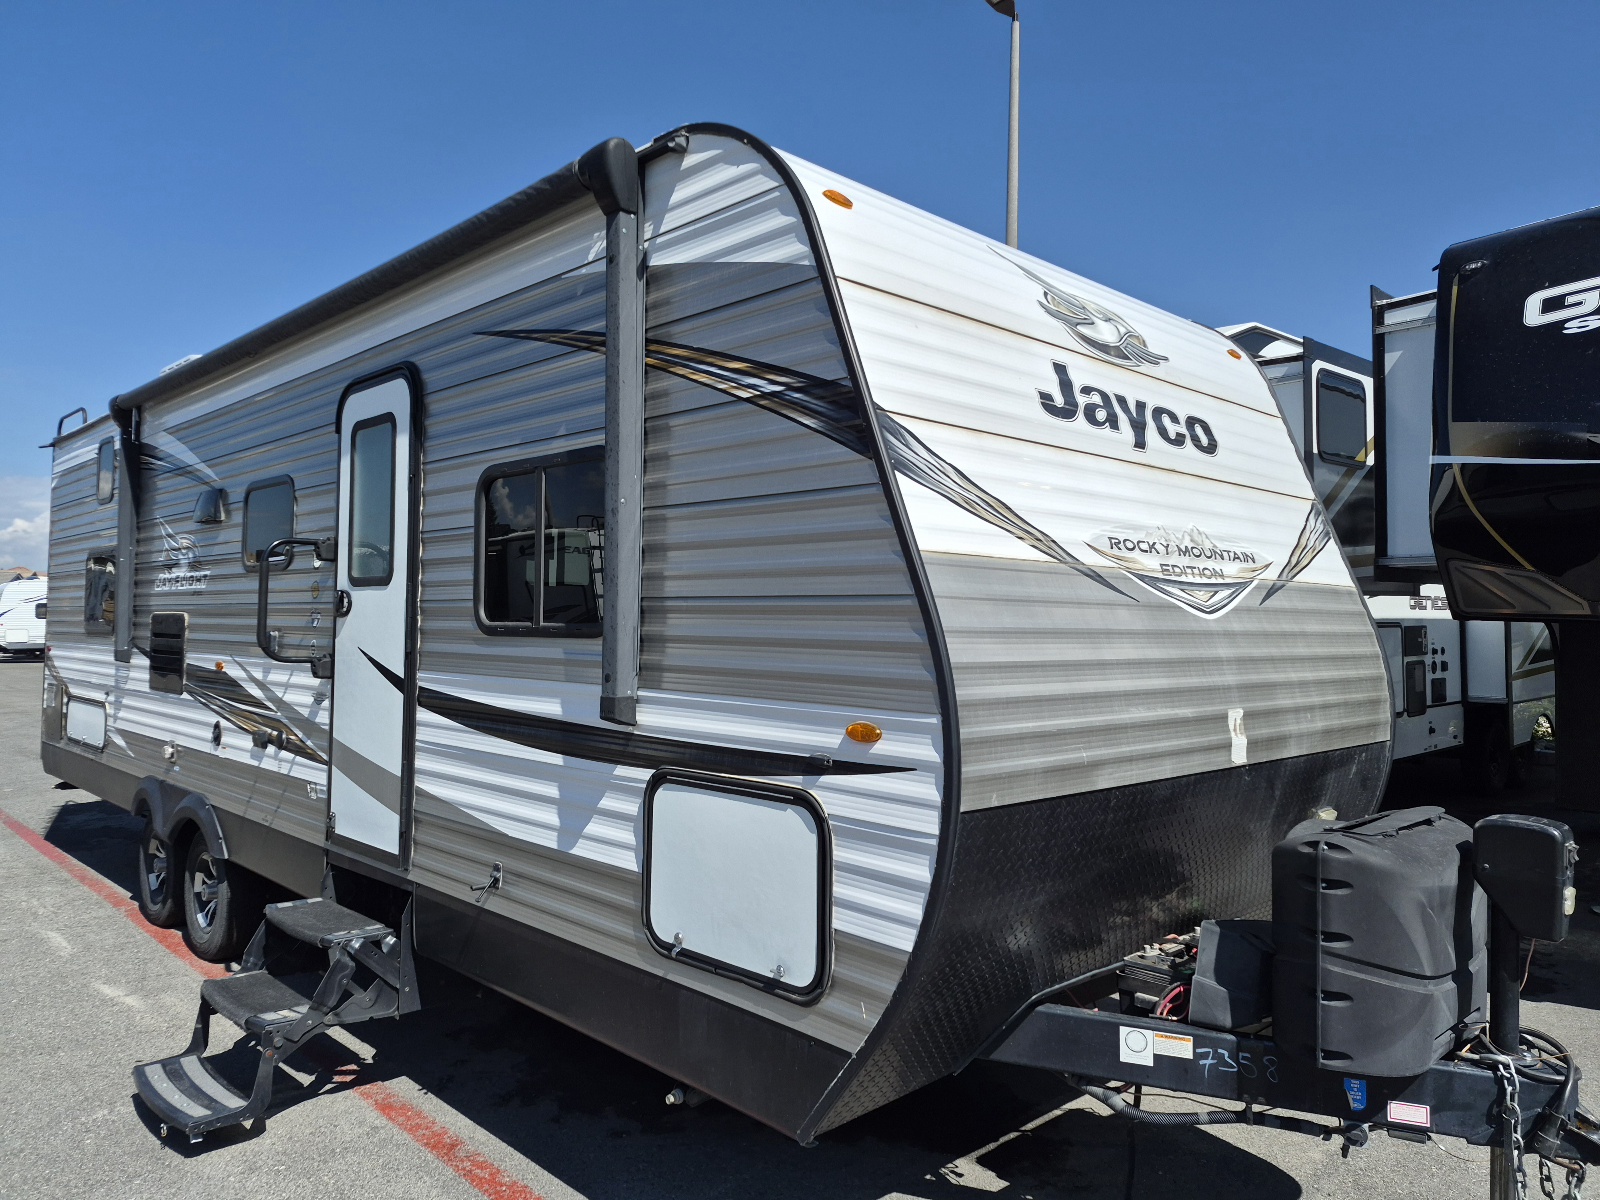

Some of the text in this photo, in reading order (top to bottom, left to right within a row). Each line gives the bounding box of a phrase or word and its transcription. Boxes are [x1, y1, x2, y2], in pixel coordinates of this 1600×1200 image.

[1035, 359, 1219, 457] Jayco
[1107, 536, 1256, 564] ROCKY MOUNTAIN
[1159, 563, 1225, 580] EDITION
[1409, 596, 1450, 610] GENES
[1195, 1048, 1278, 1083] 7358
